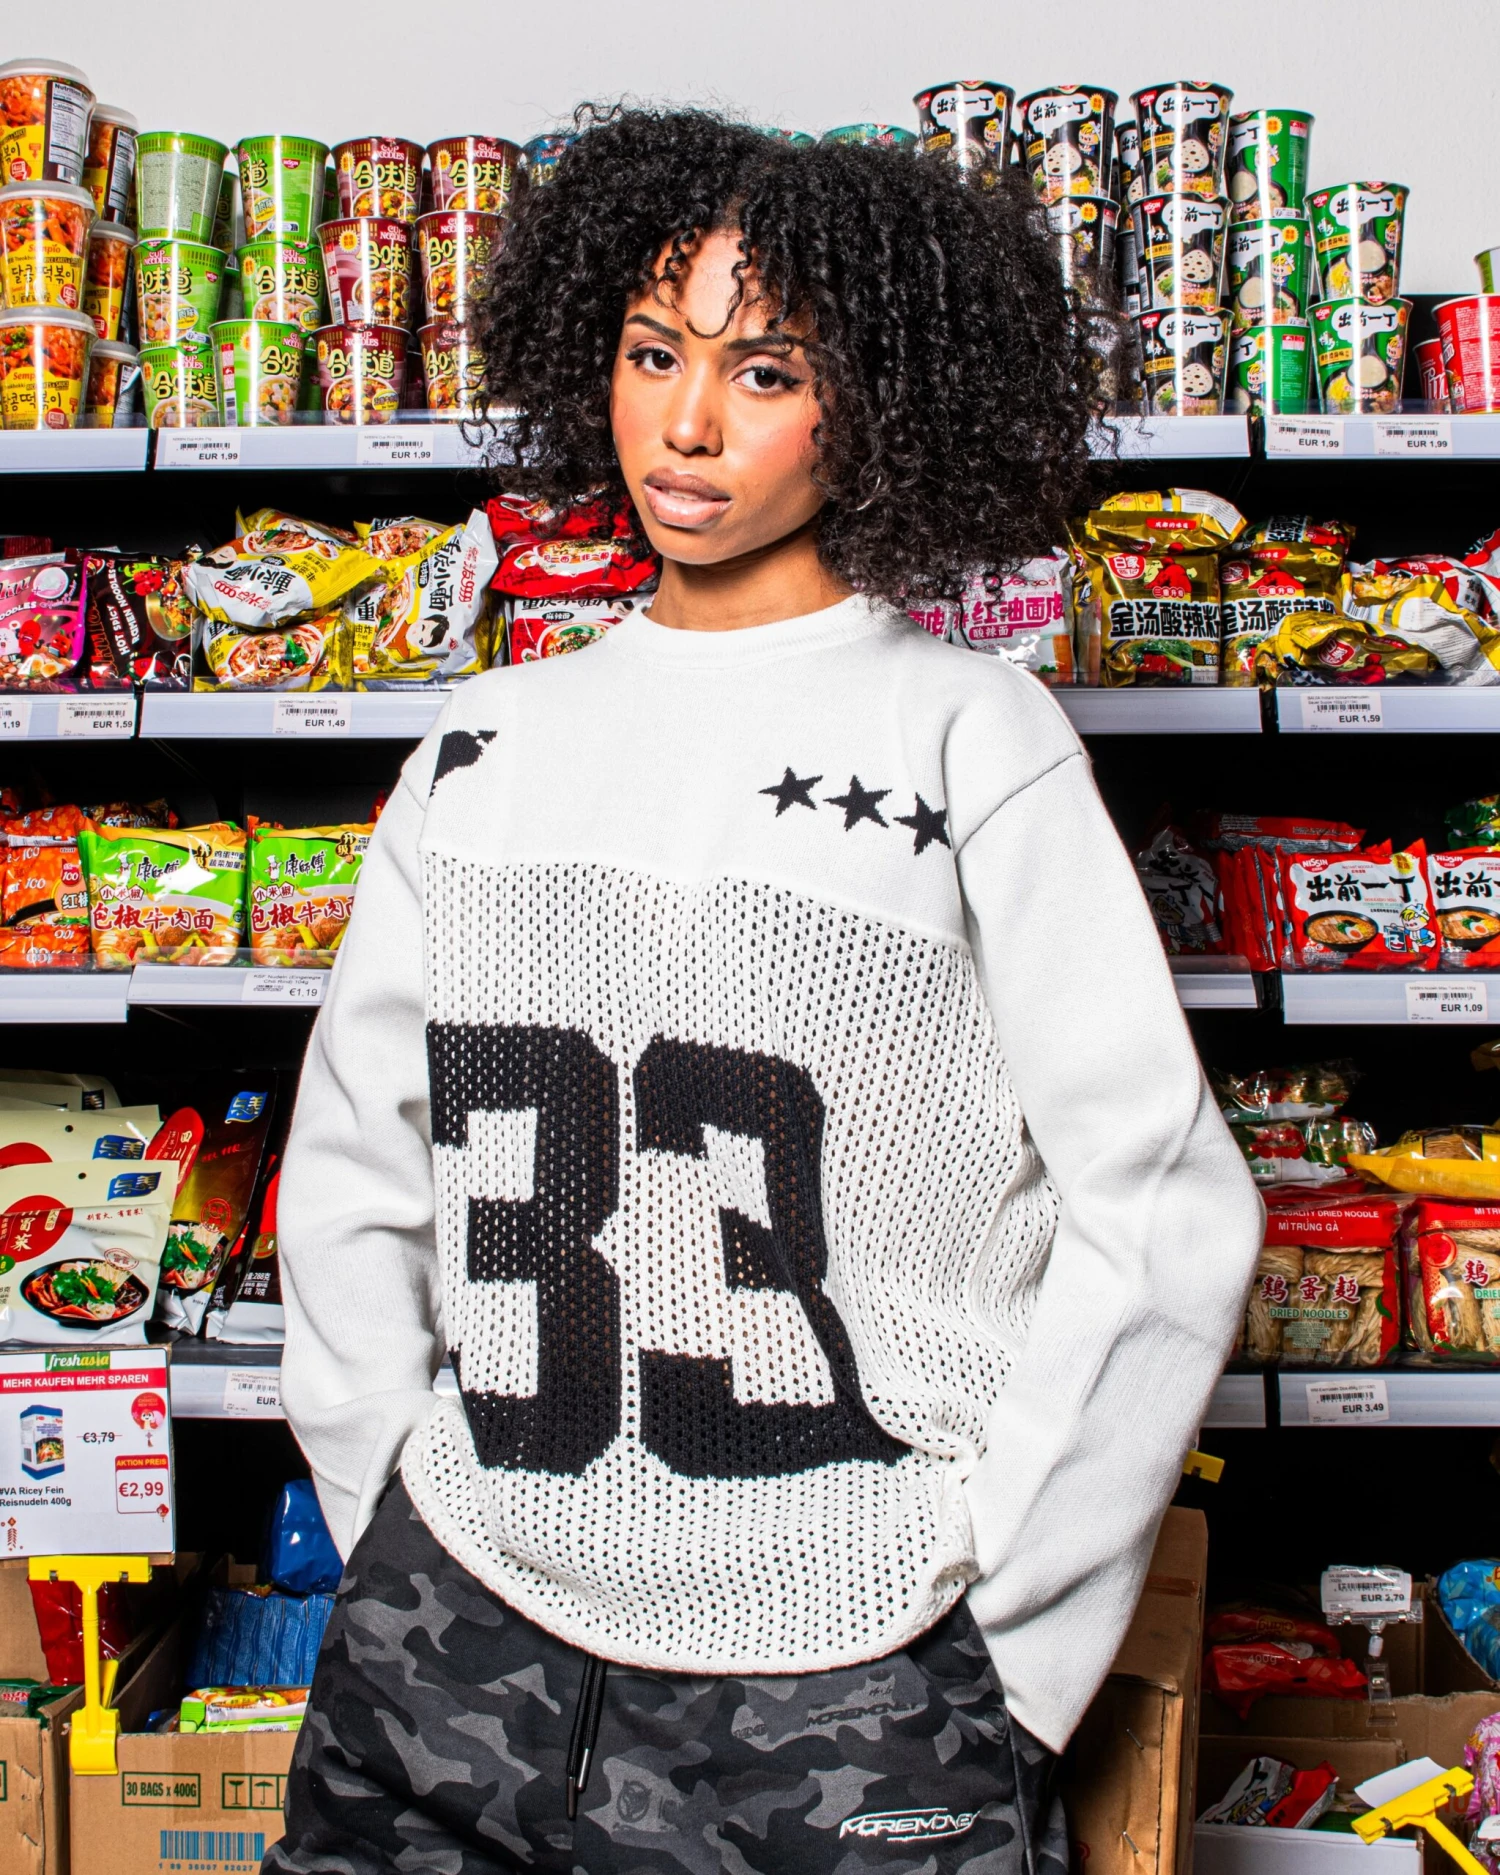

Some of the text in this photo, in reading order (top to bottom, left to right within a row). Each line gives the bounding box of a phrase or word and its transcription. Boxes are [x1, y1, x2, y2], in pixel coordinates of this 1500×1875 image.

[1298, 438, 1339, 448] EUR 1,99
[1407, 440, 1448, 448] EUR 1,99
[221, 452, 238, 460] 1,99
[413, 451, 431, 459] 1,99
[1113, 555, 1141, 568] 白家
[108, 566, 141, 645] RAMEN NOODLES
[106, 604, 131, 657] HOT SPICY
[973, 625, 1010, 640] 酸辣面
[305, 719, 346, 728] EUR 1,49
[1339, 714, 1381, 723] EUR 1,59
[3, 720, 21, 729] 1,19
[115, 720, 133, 729] 1,59
[1301, 858, 1328, 869] NISSIN
[62, 871, 79, 881] 100
[1306, 873, 1416, 903] 出前一丁
[1435, 871, 1500, 900] 出前
[255, 882, 293, 901] 小米椒
[1440, 1003, 1483, 1012] EUR 1,09
[1317, 1209, 1343, 1217] DRIED
[1344, 1210, 1379, 1218] NOODLE
[1325, 1219, 1339, 1232] GÀ
[1270, 1308, 1349, 1320] DRIED NOODLES
[46, 1352, 110, 1371] freshasia
[3, 1374, 149, 1388] MEHR KAUFEN MEHR SPAREN
[256, 1396, 276, 1405] EUR
[1342, 1402, 1384, 1413] EUR 3,49
[82, 1431, 116, 1444] €3,79
[116, 1457, 167, 1467] AKTION PREIS
[18, 1485, 43, 1497] Ricey
[44, 1485, 64, 1495] Fein
[118, 1481, 164, 1499] €2,99
[50, 1497, 72, 1508] 400g
[1360, 1594, 1382, 1602] EUR
[126, 1782, 138, 1796] 30
[140, 1782, 164, 1797] BAGS
[173, 1782, 197, 1798] 400G
